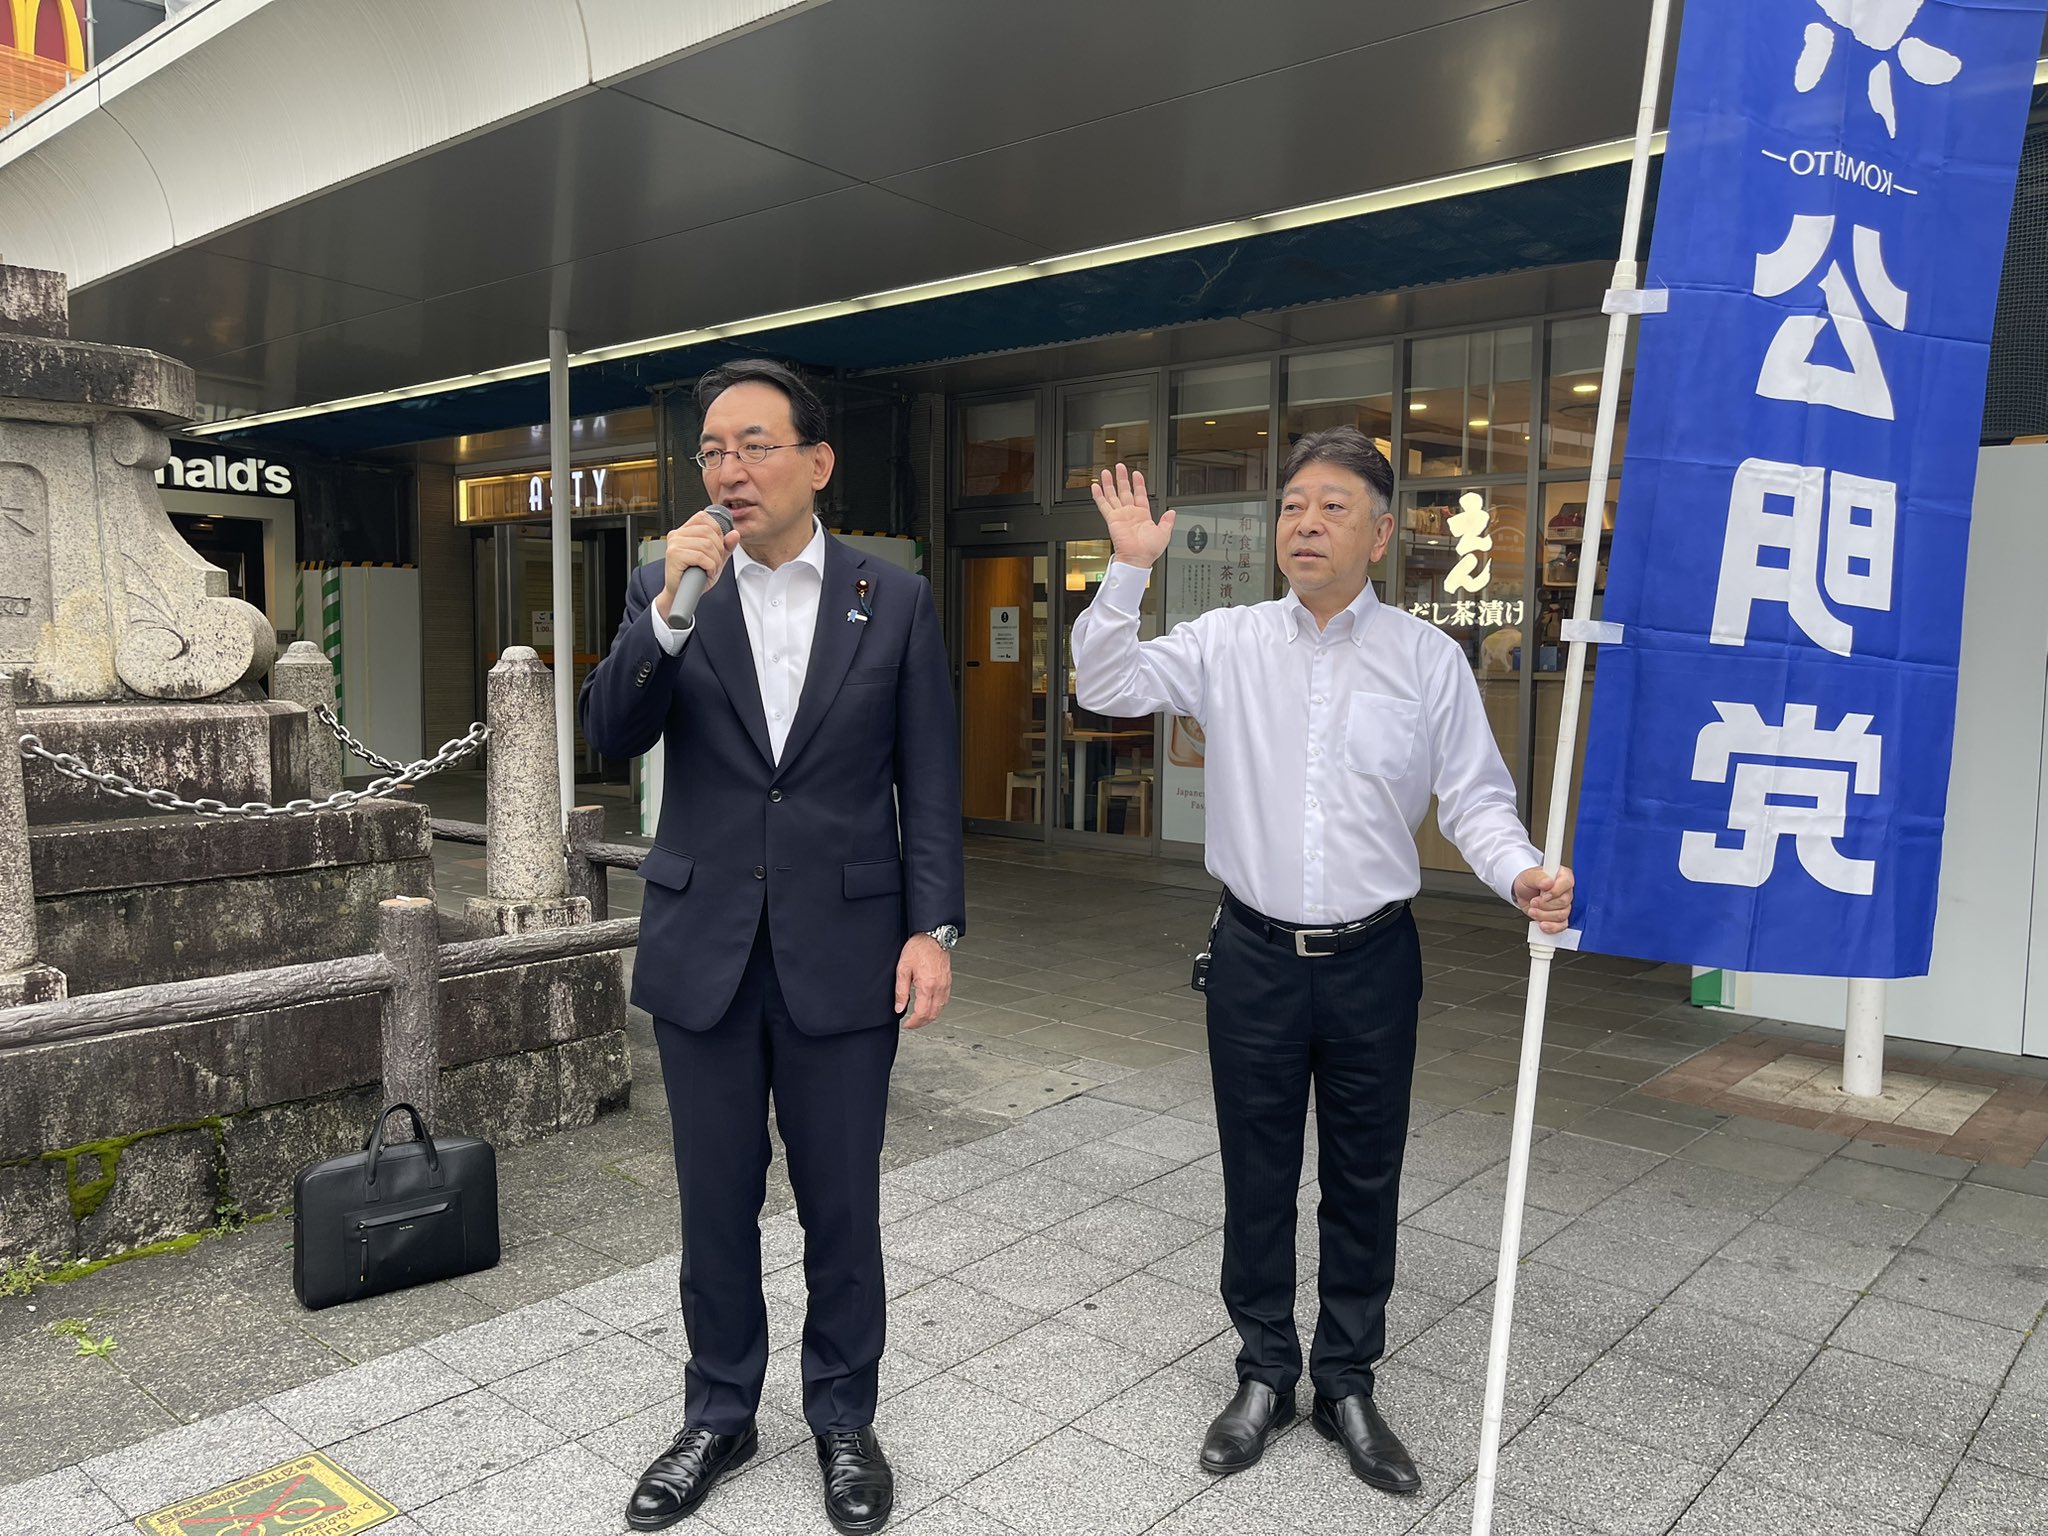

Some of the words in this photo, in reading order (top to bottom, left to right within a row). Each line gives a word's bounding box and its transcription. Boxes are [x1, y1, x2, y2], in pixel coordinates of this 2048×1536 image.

[529, 468, 606, 512] ATY
[1238, 517, 1253, 583] 和食屋の
[1444, 492, 1493, 594] えん
[1409, 600, 1525, 626] だし茶漬け
